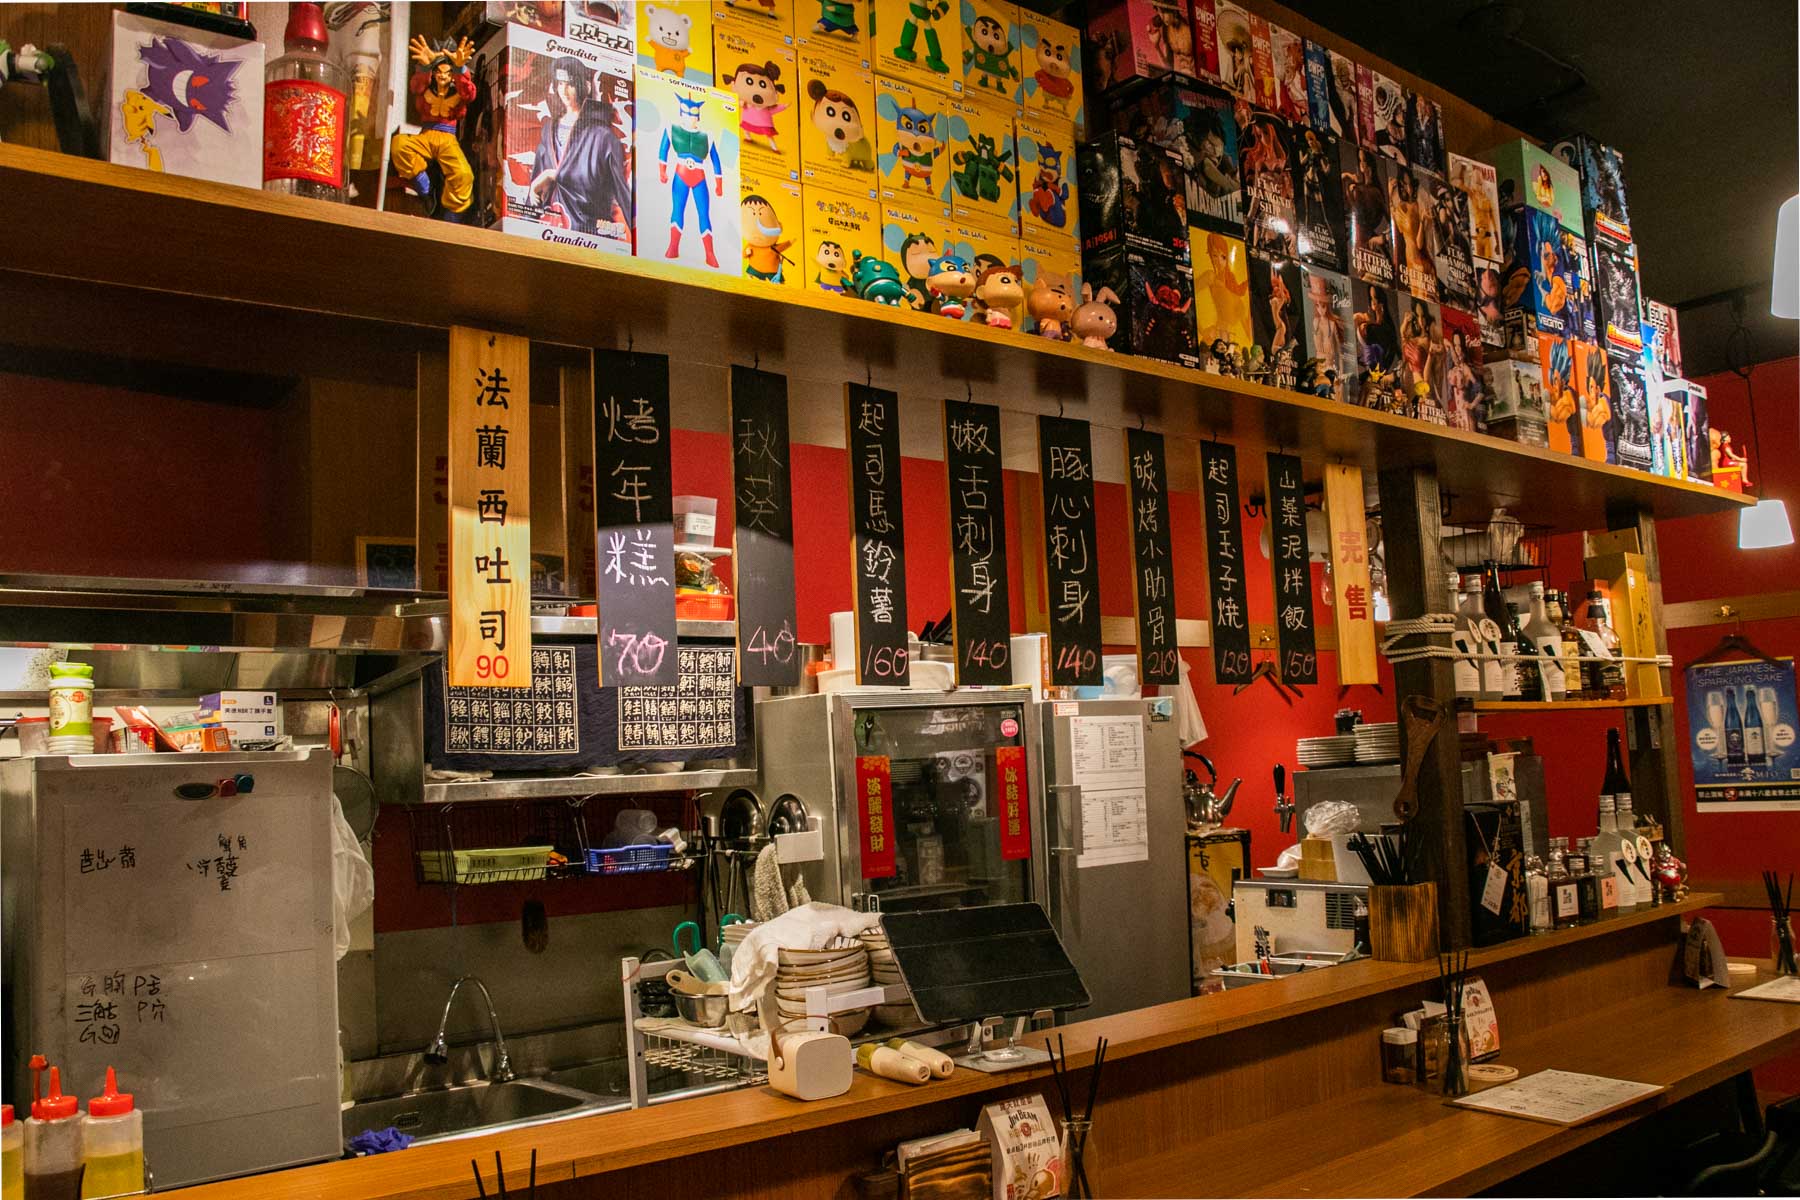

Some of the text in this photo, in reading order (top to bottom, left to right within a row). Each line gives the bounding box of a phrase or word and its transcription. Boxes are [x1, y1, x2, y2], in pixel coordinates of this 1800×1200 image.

[546, 39, 598, 62] Grandista
[1258, 178, 1280, 194] FLAG
[542, 229, 598, 250] Grandista
[602, 396, 669, 586] 烤年糕
[738, 418, 784, 538] 秋葵
[475, 368, 511, 652] 法蘭西吐司
[858, 401, 896, 624] 起司馬鈴薯
[950, 419, 998, 614] 嫩舌刺身
[1050, 446, 1090, 625] 豚心刺身
[1134, 450, 1166, 646] 碳烤小肋骨
[1208, 458, 1244, 630] 起司玉子燒
[1338, 531, 1368, 620] 完售
[608, 628, 668, 676] 70
[748, 620, 794, 666] 40
[965, 638, 1008, 670] 140
[476, 655, 510, 679] 90
[552, 651, 570, 670] 鮎
[865, 644, 908, 678] 160
[1056, 644, 1096, 678] 140
[1146, 651, 1177, 676] 210
[1220, 650, 1248, 676] 120
[1284, 650, 1316, 677] 150
[1726, 664, 1776, 675] JAPANESE
[1698, 673, 1784, 687] SPARKLING SAKE
[555, 702, 570, 719] 鮨
[624, 700, 642, 716] 鮭
[1008, 1109, 1038, 1128] JIM BEAM
